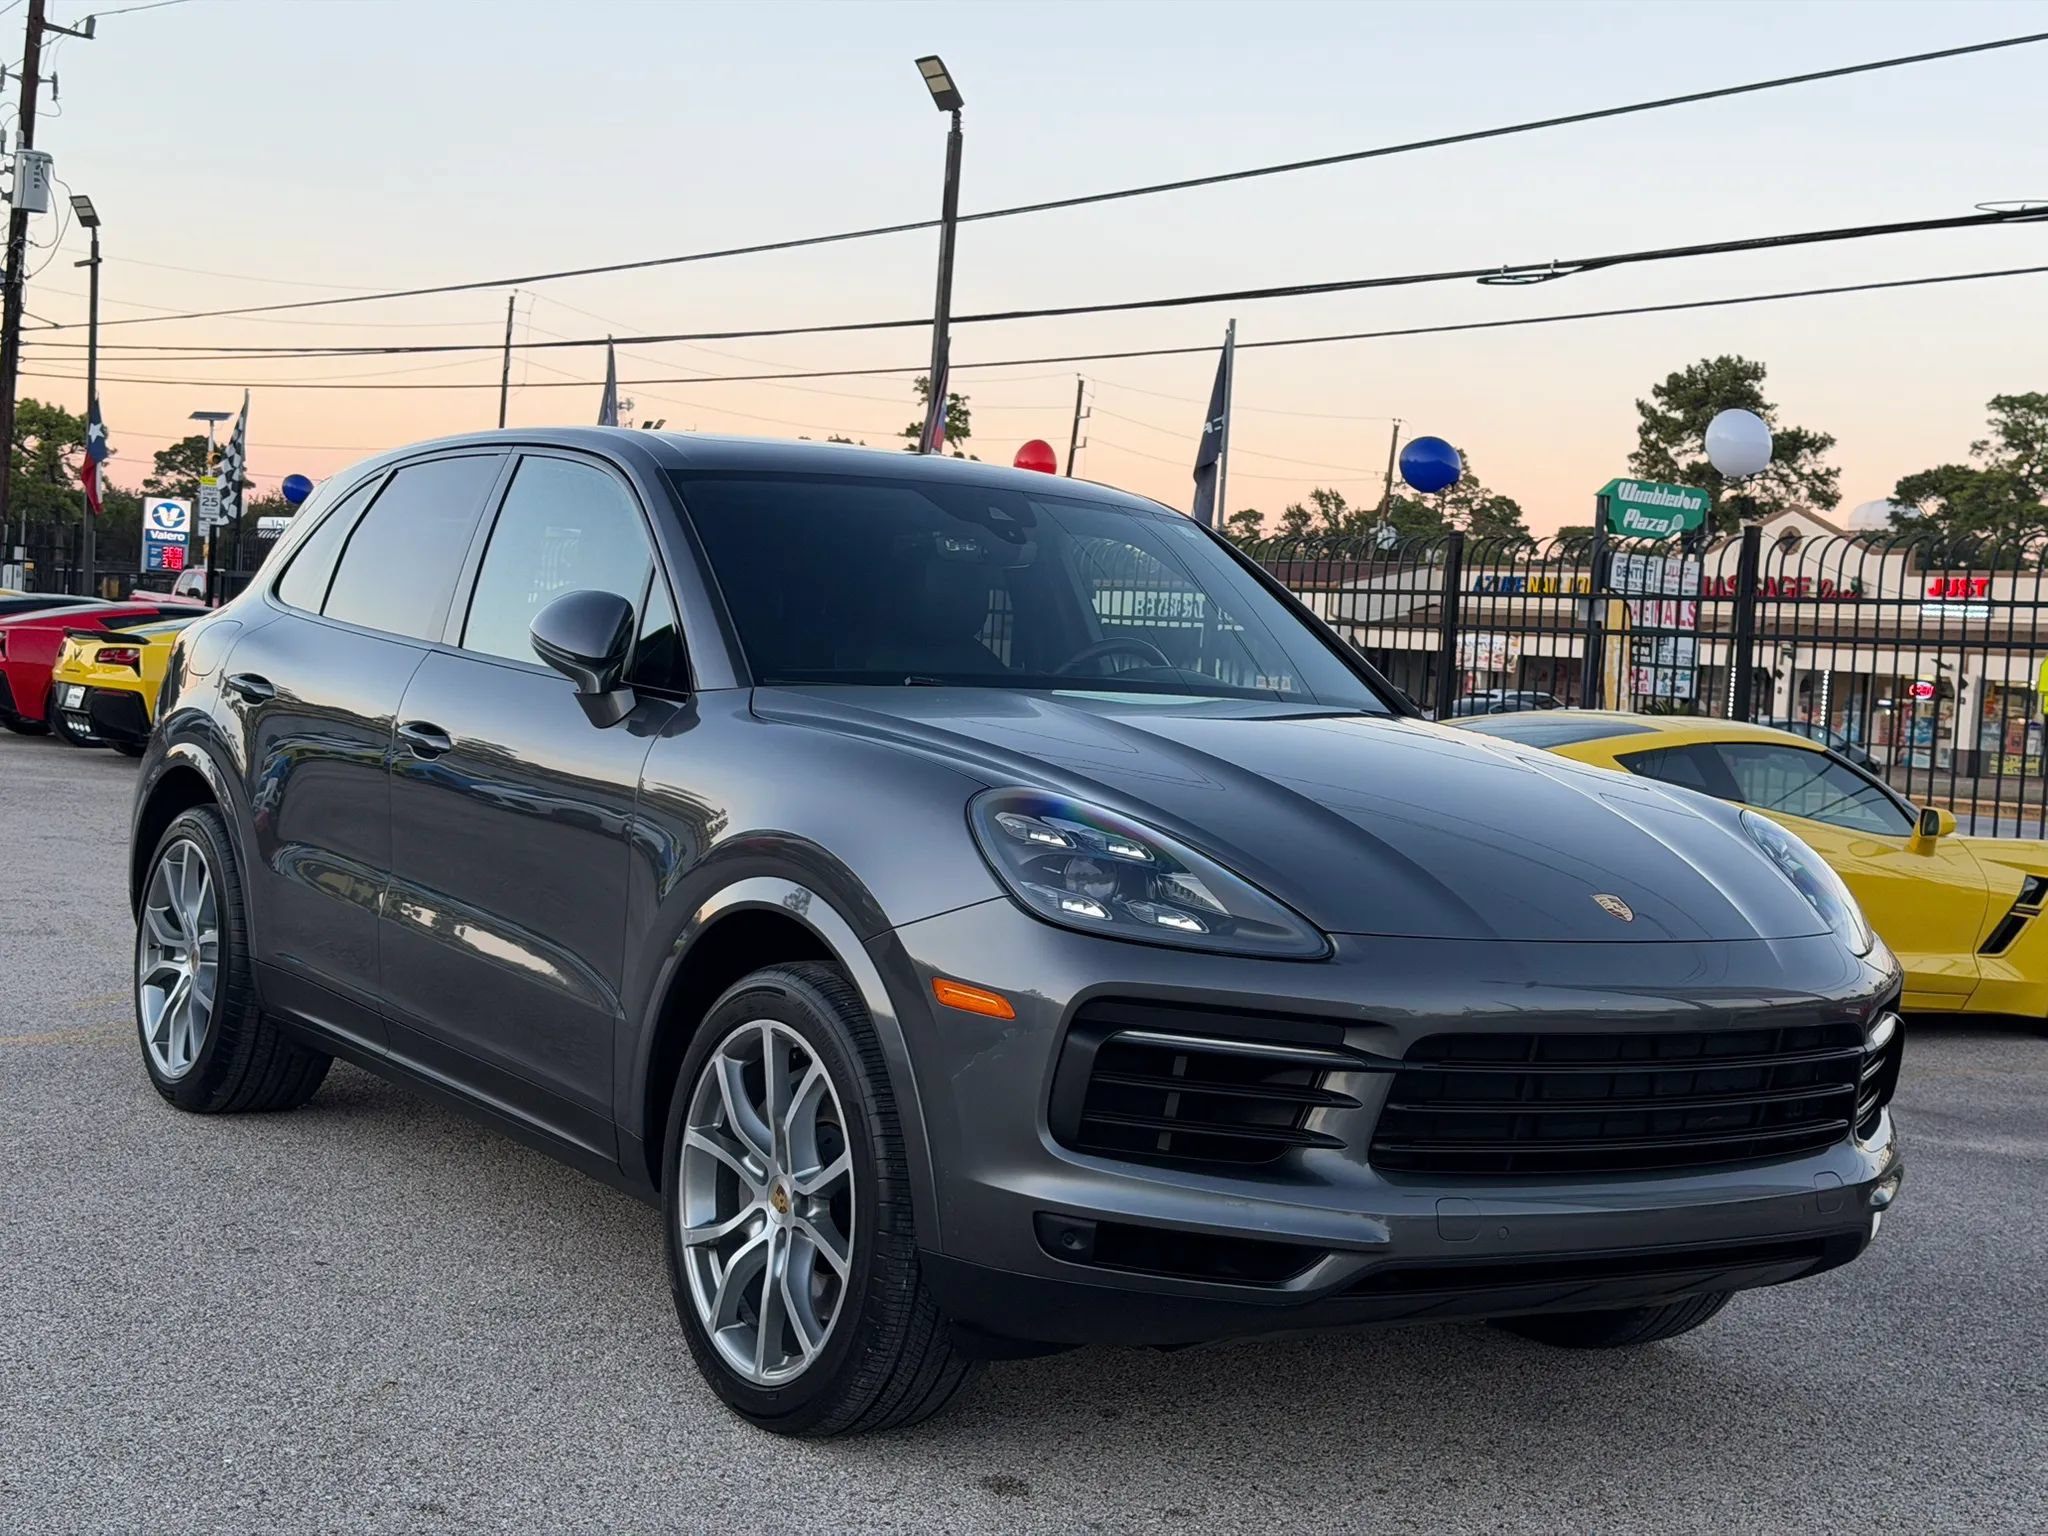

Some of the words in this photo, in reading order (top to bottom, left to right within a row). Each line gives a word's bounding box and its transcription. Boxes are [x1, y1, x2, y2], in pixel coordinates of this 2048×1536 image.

[202, 496, 219, 507] 25
[1617, 481, 1702, 511] Wimbledon
[1623, 508, 1670, 533] Plaza
[150, 530, 186, 542] Valero
[1616, 565, 1654, 582] DENTIT
